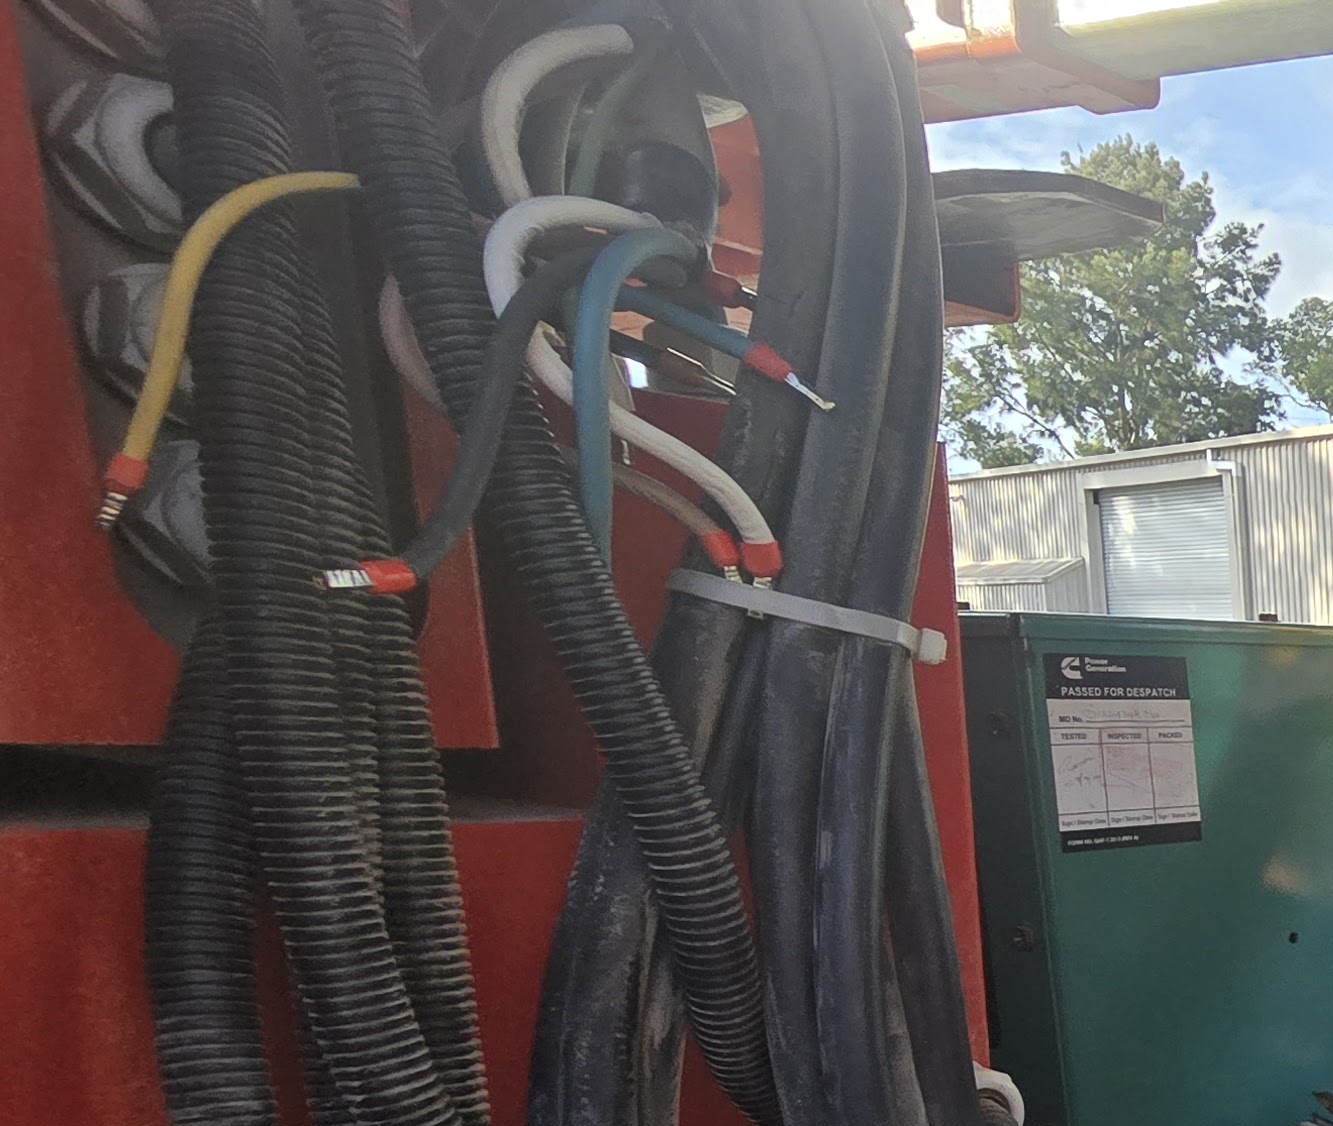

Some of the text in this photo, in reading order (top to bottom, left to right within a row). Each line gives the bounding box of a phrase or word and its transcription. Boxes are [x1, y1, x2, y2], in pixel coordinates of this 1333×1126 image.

[1084, 657, 1108, 665] Power
[1085, 665, 1127, 673] Generation
[1061, 687, 1176, 697] PASSED FOR DESPATCH
